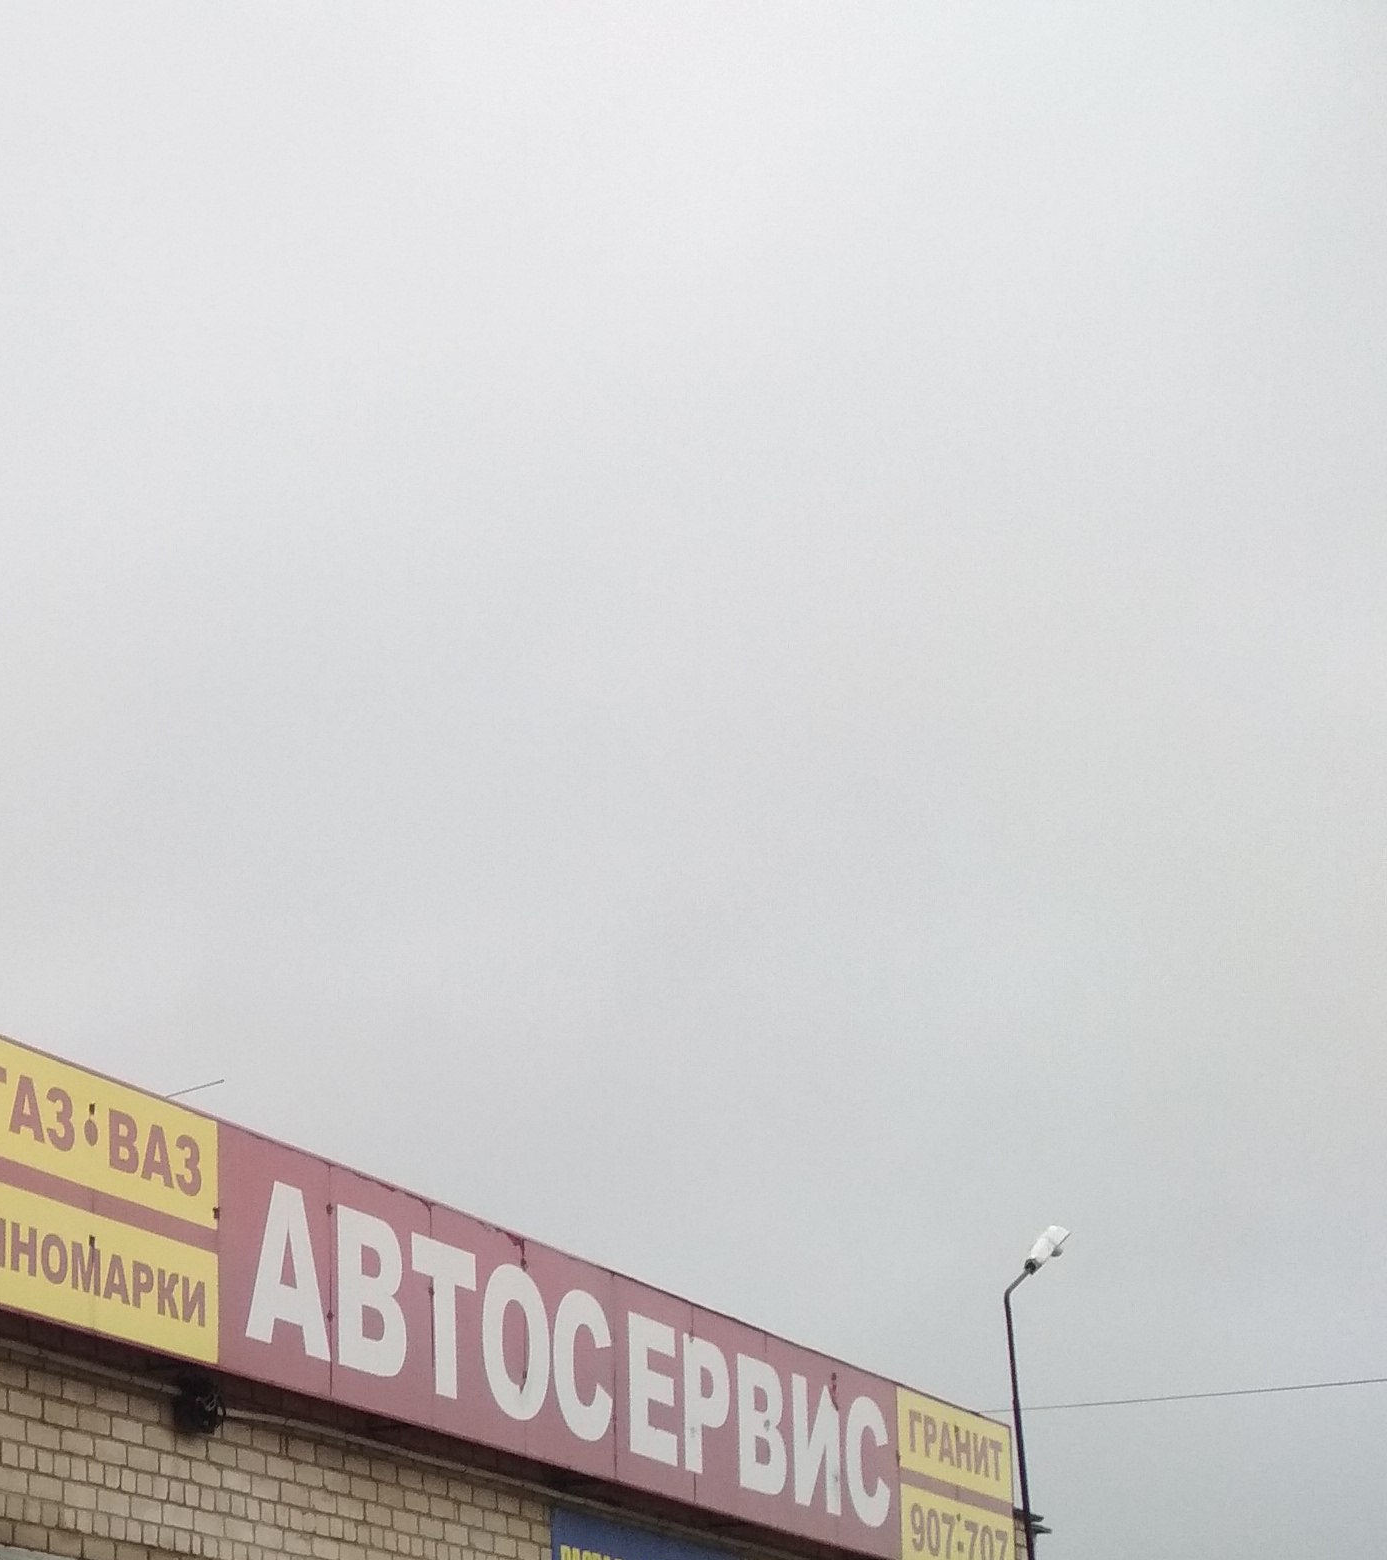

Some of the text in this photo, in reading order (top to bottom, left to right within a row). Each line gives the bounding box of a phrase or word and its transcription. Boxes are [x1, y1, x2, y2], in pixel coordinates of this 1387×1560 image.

[108, 1108, 202, 1197] ВАЗ
[245, 1180, 891, 1528] АВТОСЕРВИС
[909, 1409, 1003, 1481] ГРАНИТ
